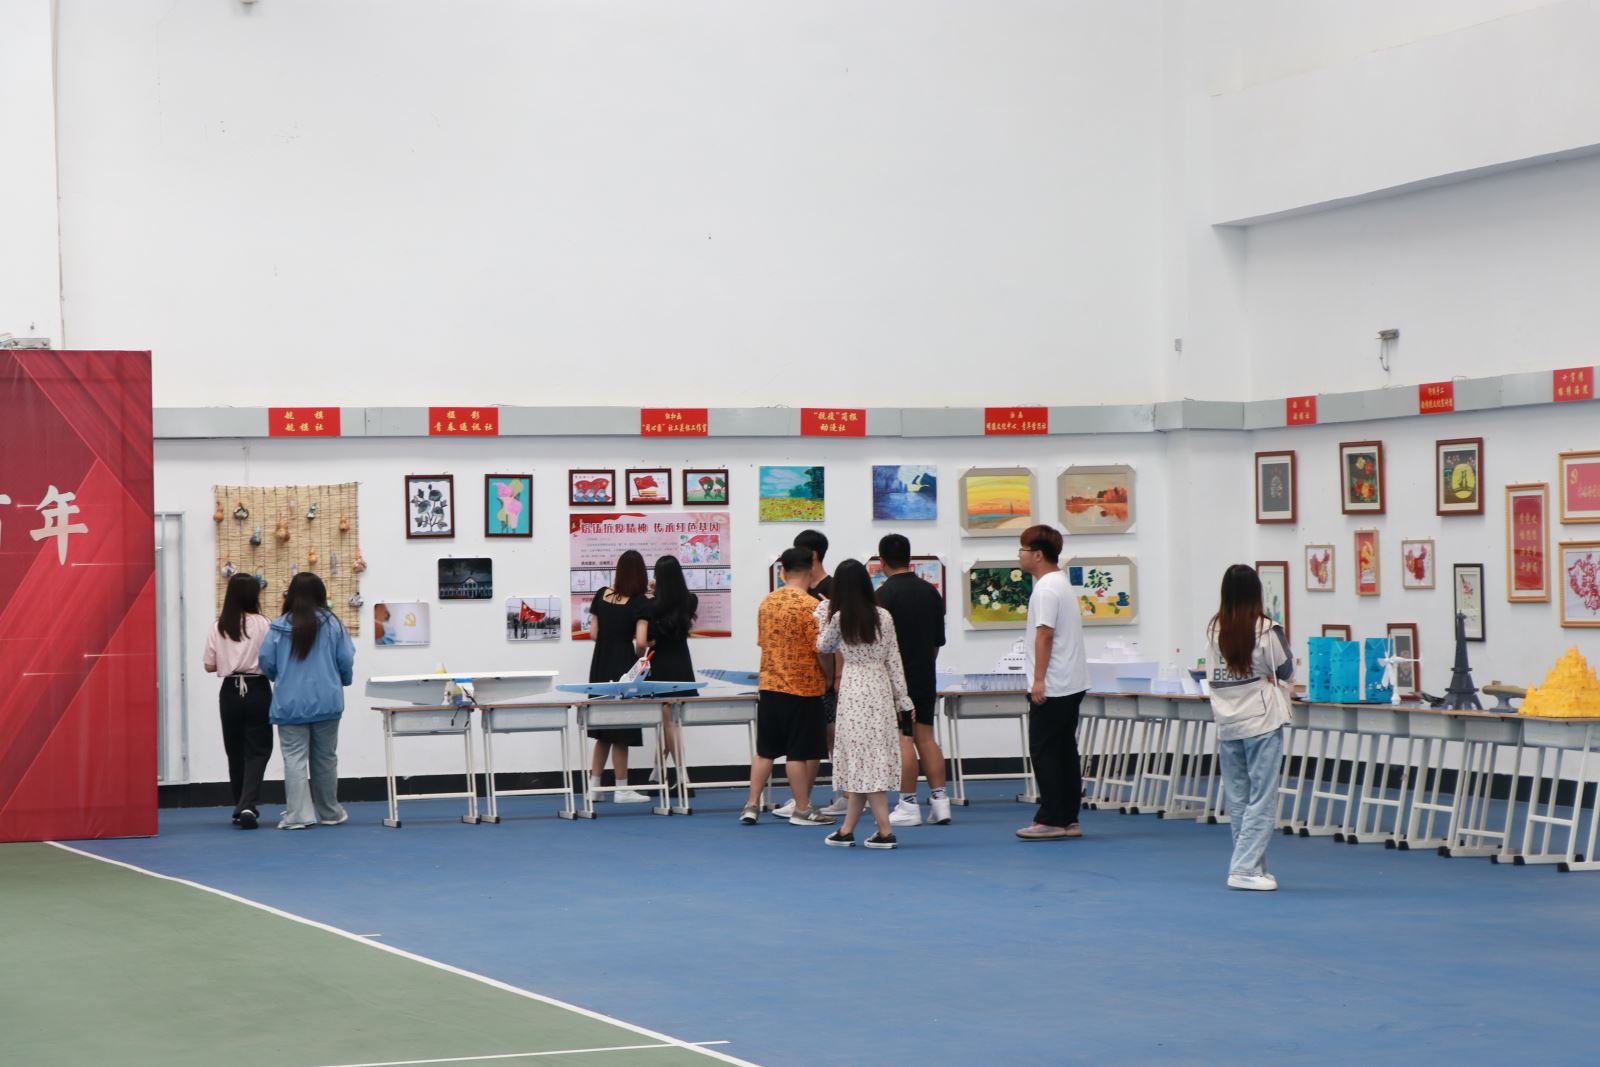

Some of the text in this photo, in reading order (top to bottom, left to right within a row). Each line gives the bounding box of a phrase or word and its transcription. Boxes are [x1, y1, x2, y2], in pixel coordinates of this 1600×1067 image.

[0, 485, 89, 566] 年
[653, 522, 720, 534] 传承红色基因
